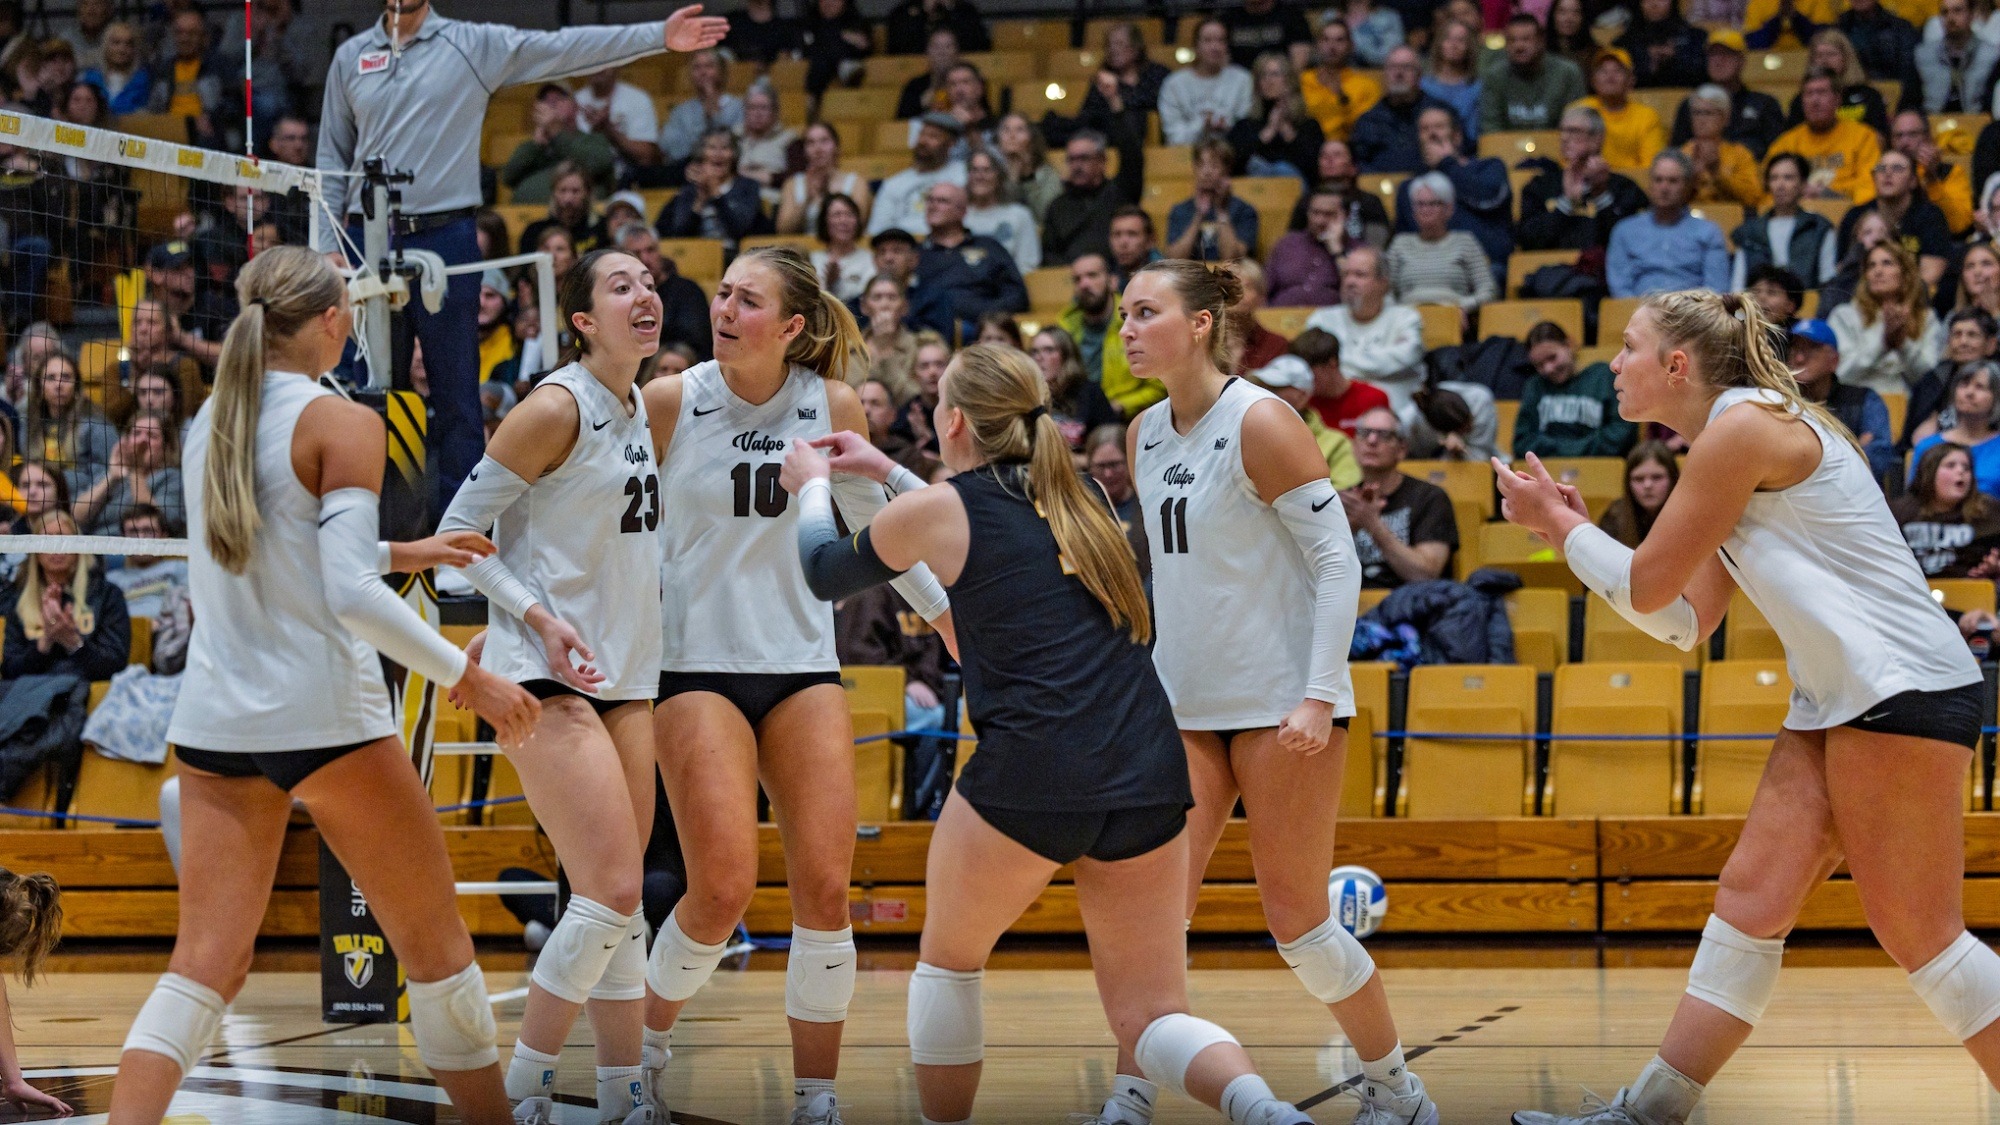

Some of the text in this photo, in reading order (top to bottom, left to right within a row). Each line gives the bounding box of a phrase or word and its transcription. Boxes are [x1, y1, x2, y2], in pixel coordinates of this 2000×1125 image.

[732, 430, 786, 455] Valpo
[730, 462, 789, 518] 10
[1163, 462, 1195, 489] Valpo
[620, 473, 660, 533] 23
[1160, 496, 1189, 554] 11
[333, 934, 384, 954] VALPO
